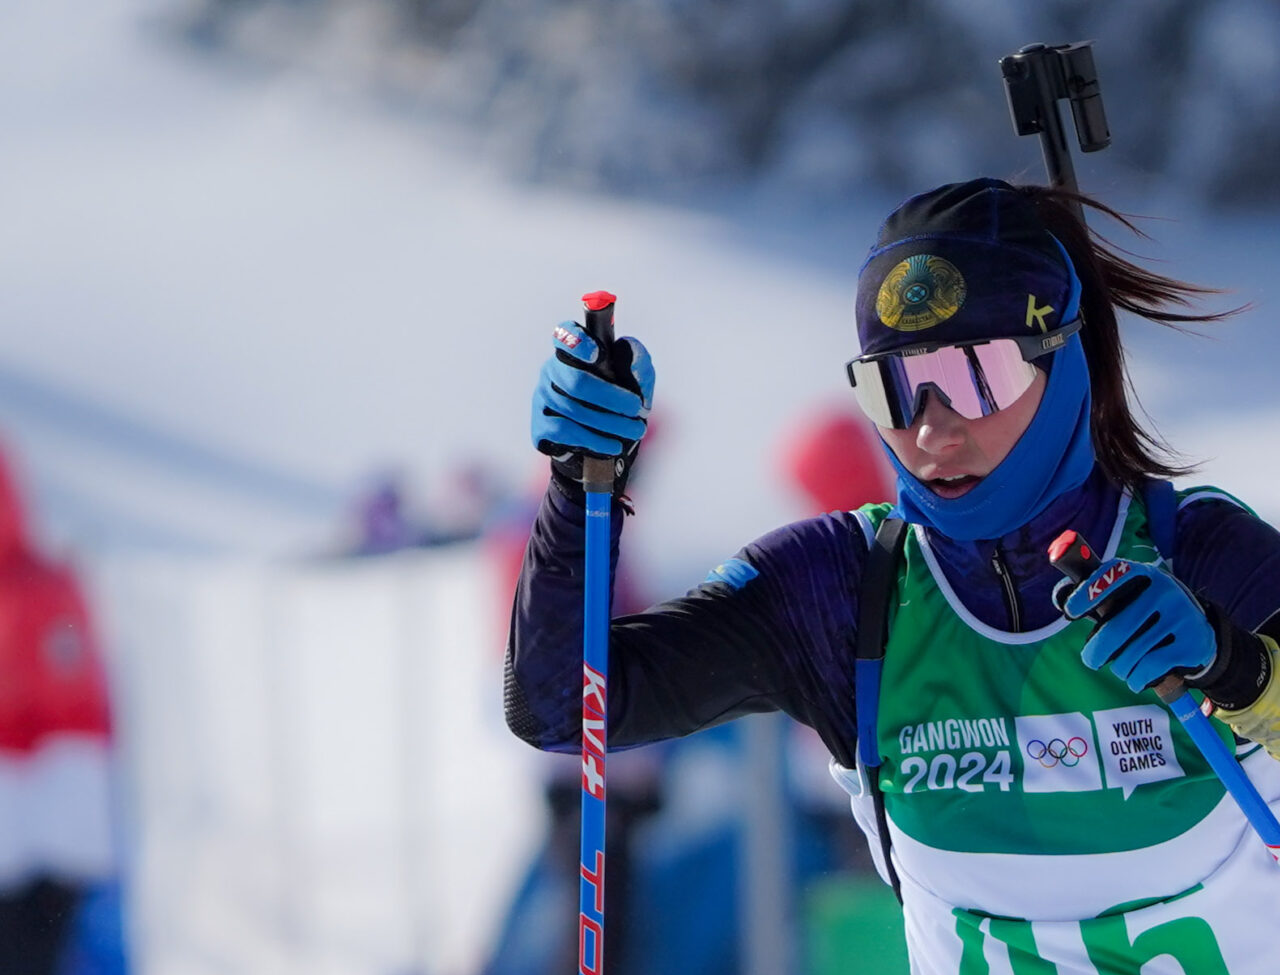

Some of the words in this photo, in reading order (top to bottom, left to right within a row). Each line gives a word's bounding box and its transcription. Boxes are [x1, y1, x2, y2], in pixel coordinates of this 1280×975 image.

[1088, 561, 1131, 601] KV+
[583, 661, 606, 800] KV+
[900, 717, 1008, 755] GANGWON
[1110, 734, 1164, 756] OLYMPIC
[1112, 718, 1153, 738] YOUTH
[901, 750, 1014, 794] 2024
[1119, 752, 1167, 773] GAMES
